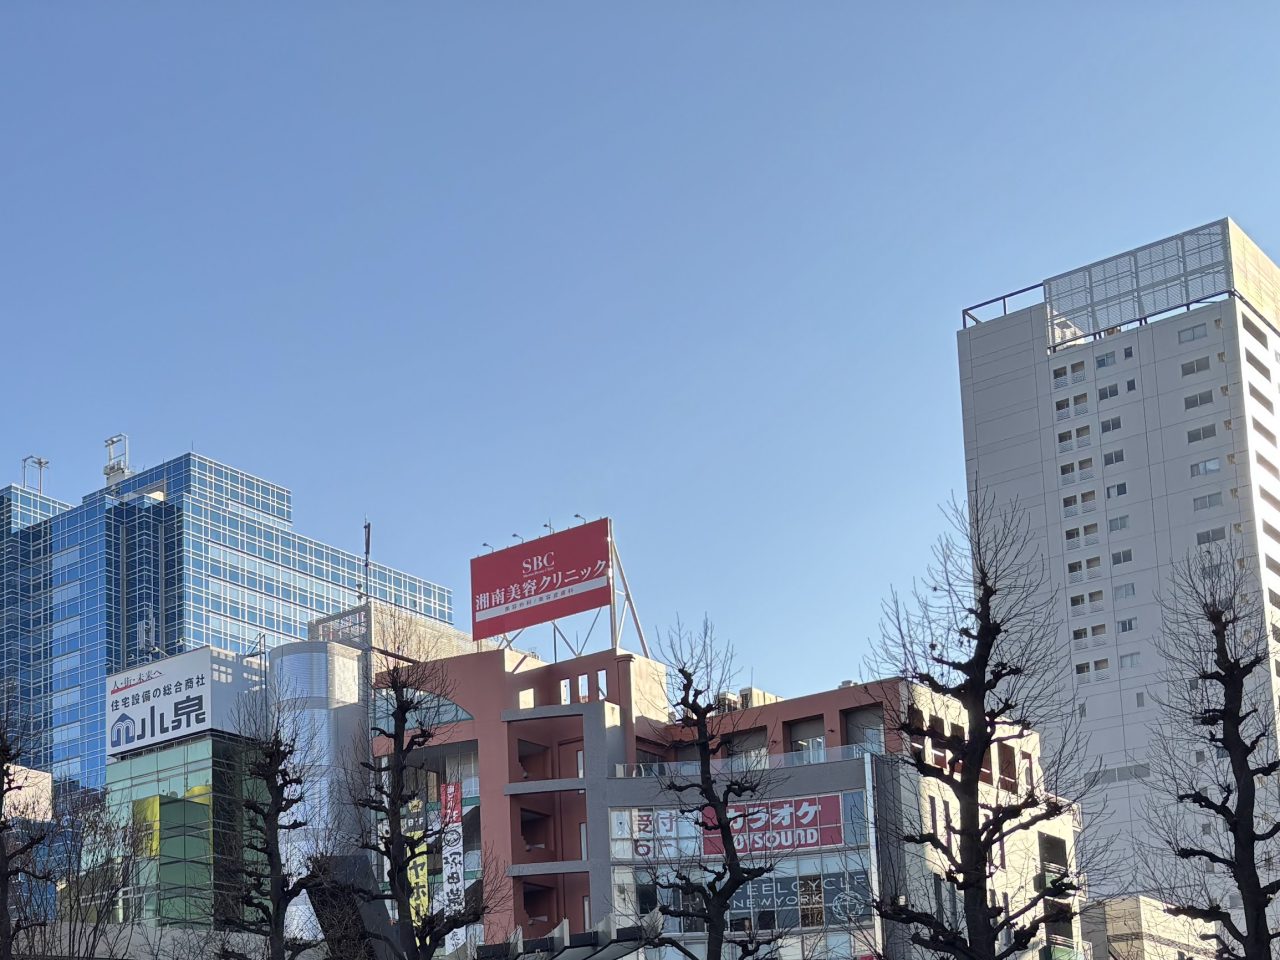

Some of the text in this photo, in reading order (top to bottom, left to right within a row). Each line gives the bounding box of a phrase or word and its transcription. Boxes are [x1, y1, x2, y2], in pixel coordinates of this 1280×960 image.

[522, 551, 555, 574] SBC
[475, 560, 607, 611] 湘南美容クリニック
[110, 673, 206, 712] 住宅設備の総合商社
[136, 694, 206, 741] 小泉
[634, 811, 675, 835] 受付
[726, 801, 822, 831] カラオケ
